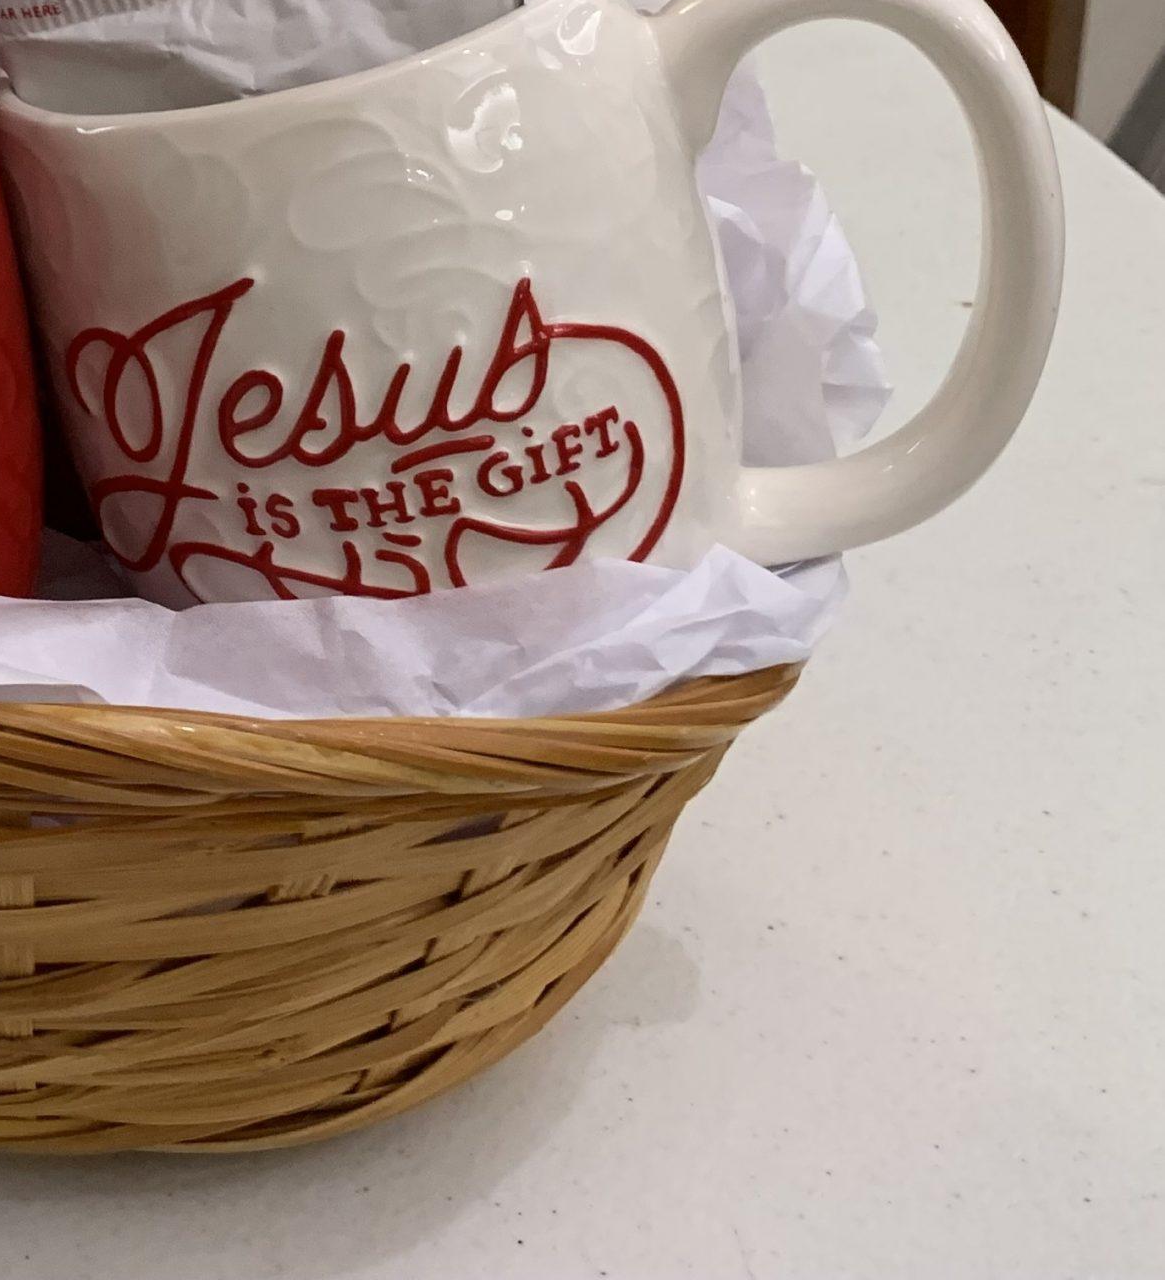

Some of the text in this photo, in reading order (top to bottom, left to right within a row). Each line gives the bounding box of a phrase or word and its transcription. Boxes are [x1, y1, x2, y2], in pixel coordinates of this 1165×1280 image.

[20, 4, 62, 18] HERE
[66, 277, 550, 571] Jesus
[313, 468, 460, 532] THE
